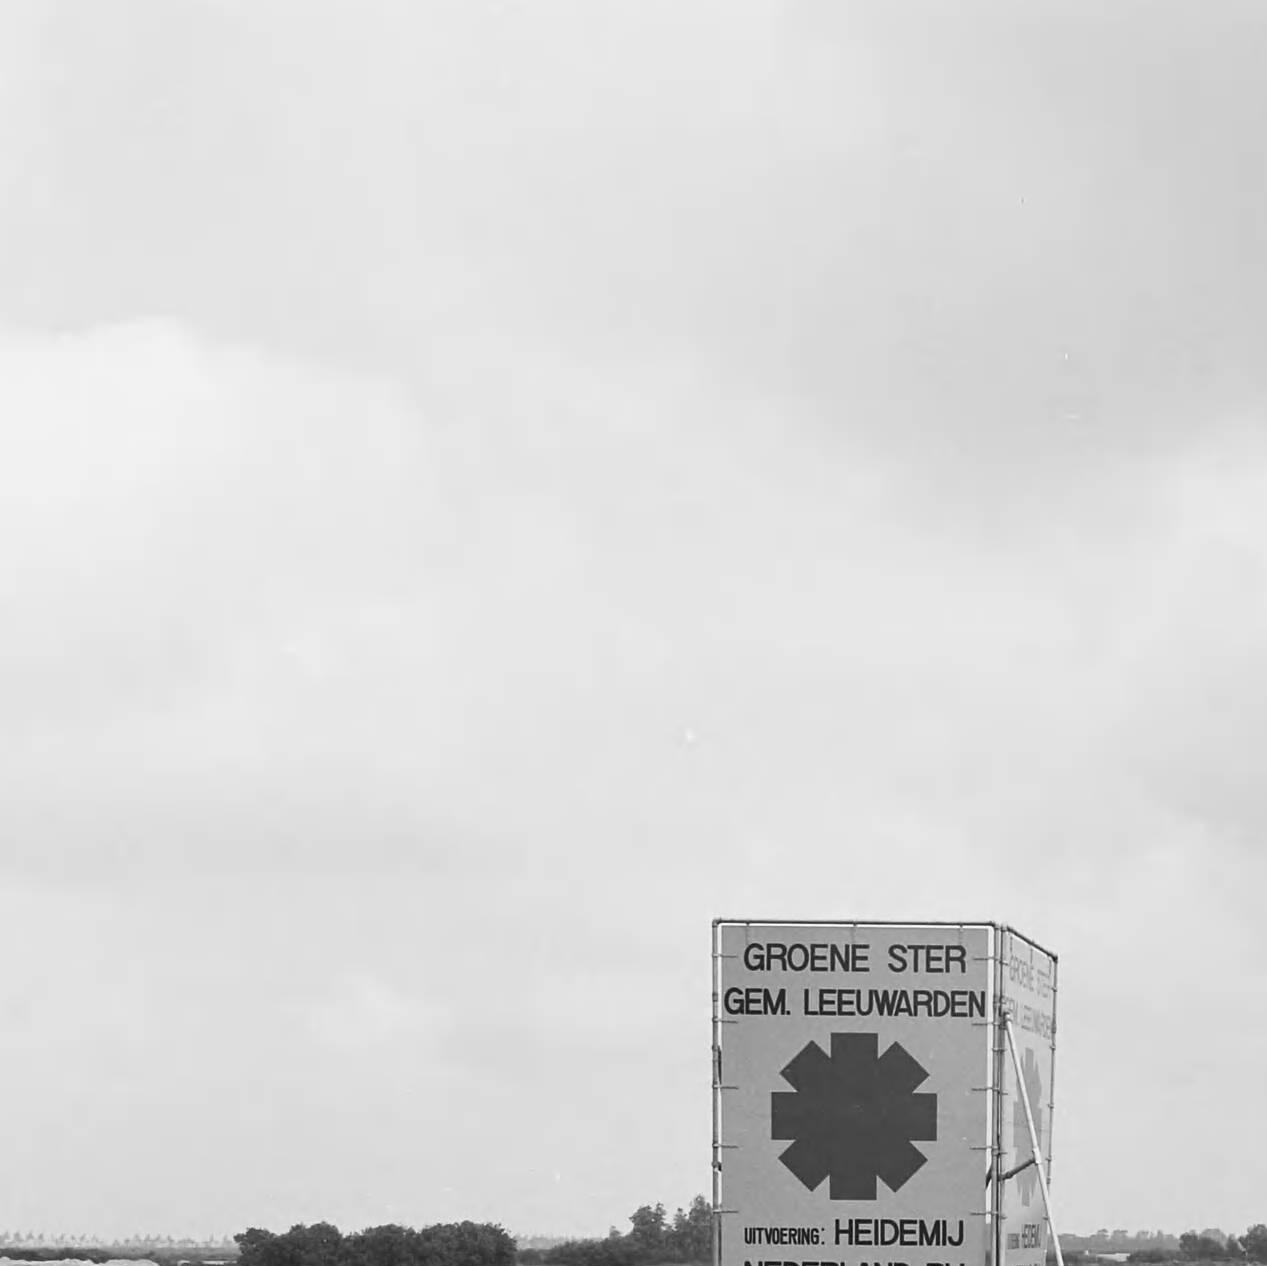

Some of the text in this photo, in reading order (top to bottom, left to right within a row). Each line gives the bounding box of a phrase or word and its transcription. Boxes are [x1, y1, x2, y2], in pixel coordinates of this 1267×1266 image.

[744, 943, 966, 973] GROENE STER
[724, 987, 790, 1015] GEM.
[804, 989, 985, 1017] LEEUWARDEN
[745, 1219, 963, 1246] UITVOERING: HEIDEMIJ
